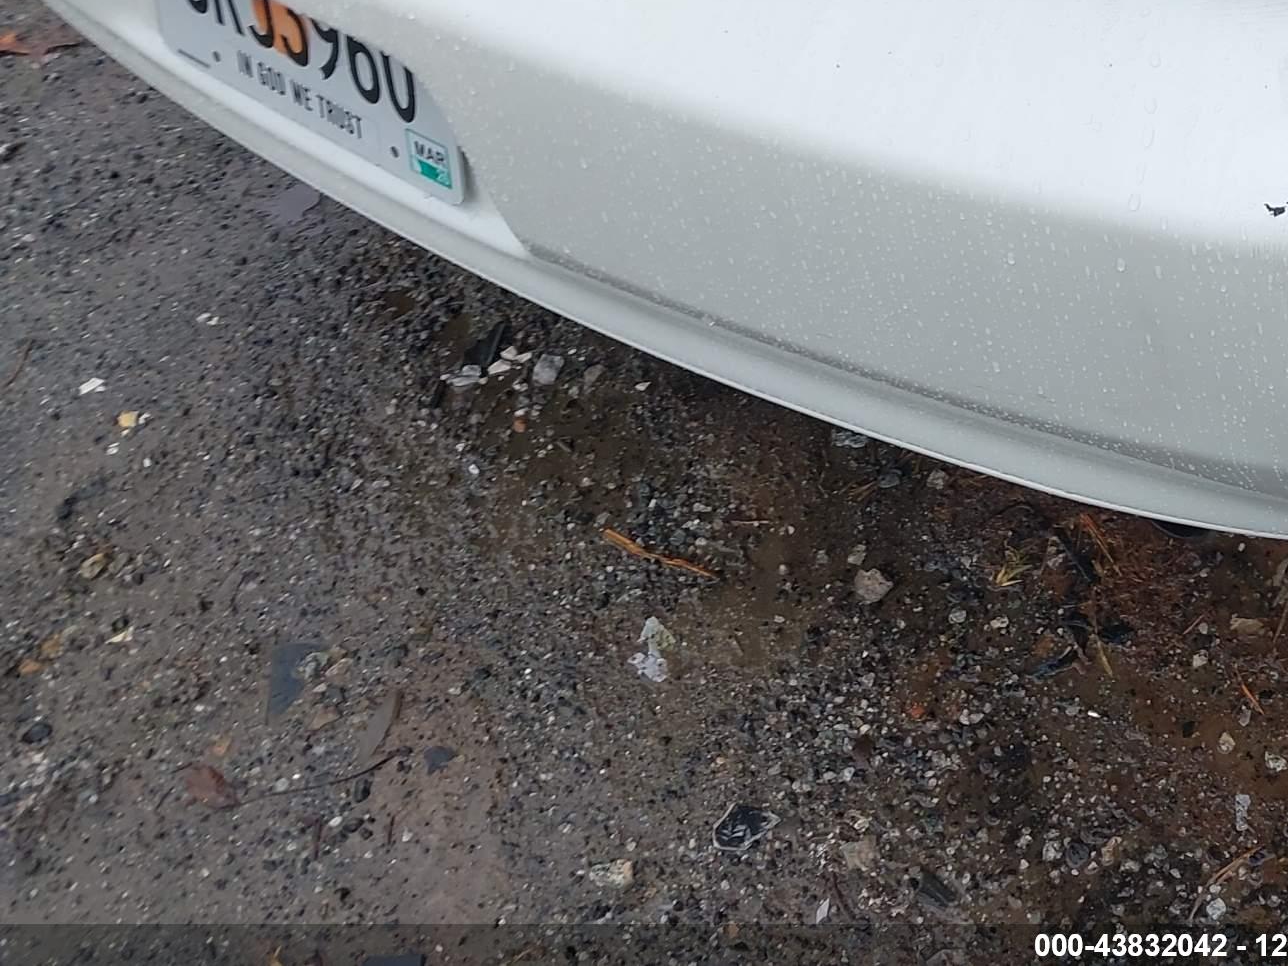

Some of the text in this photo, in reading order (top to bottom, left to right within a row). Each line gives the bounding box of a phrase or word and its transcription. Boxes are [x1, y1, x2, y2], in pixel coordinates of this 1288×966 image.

[236, 49, 363, 140] IN GOD WE TRUST
